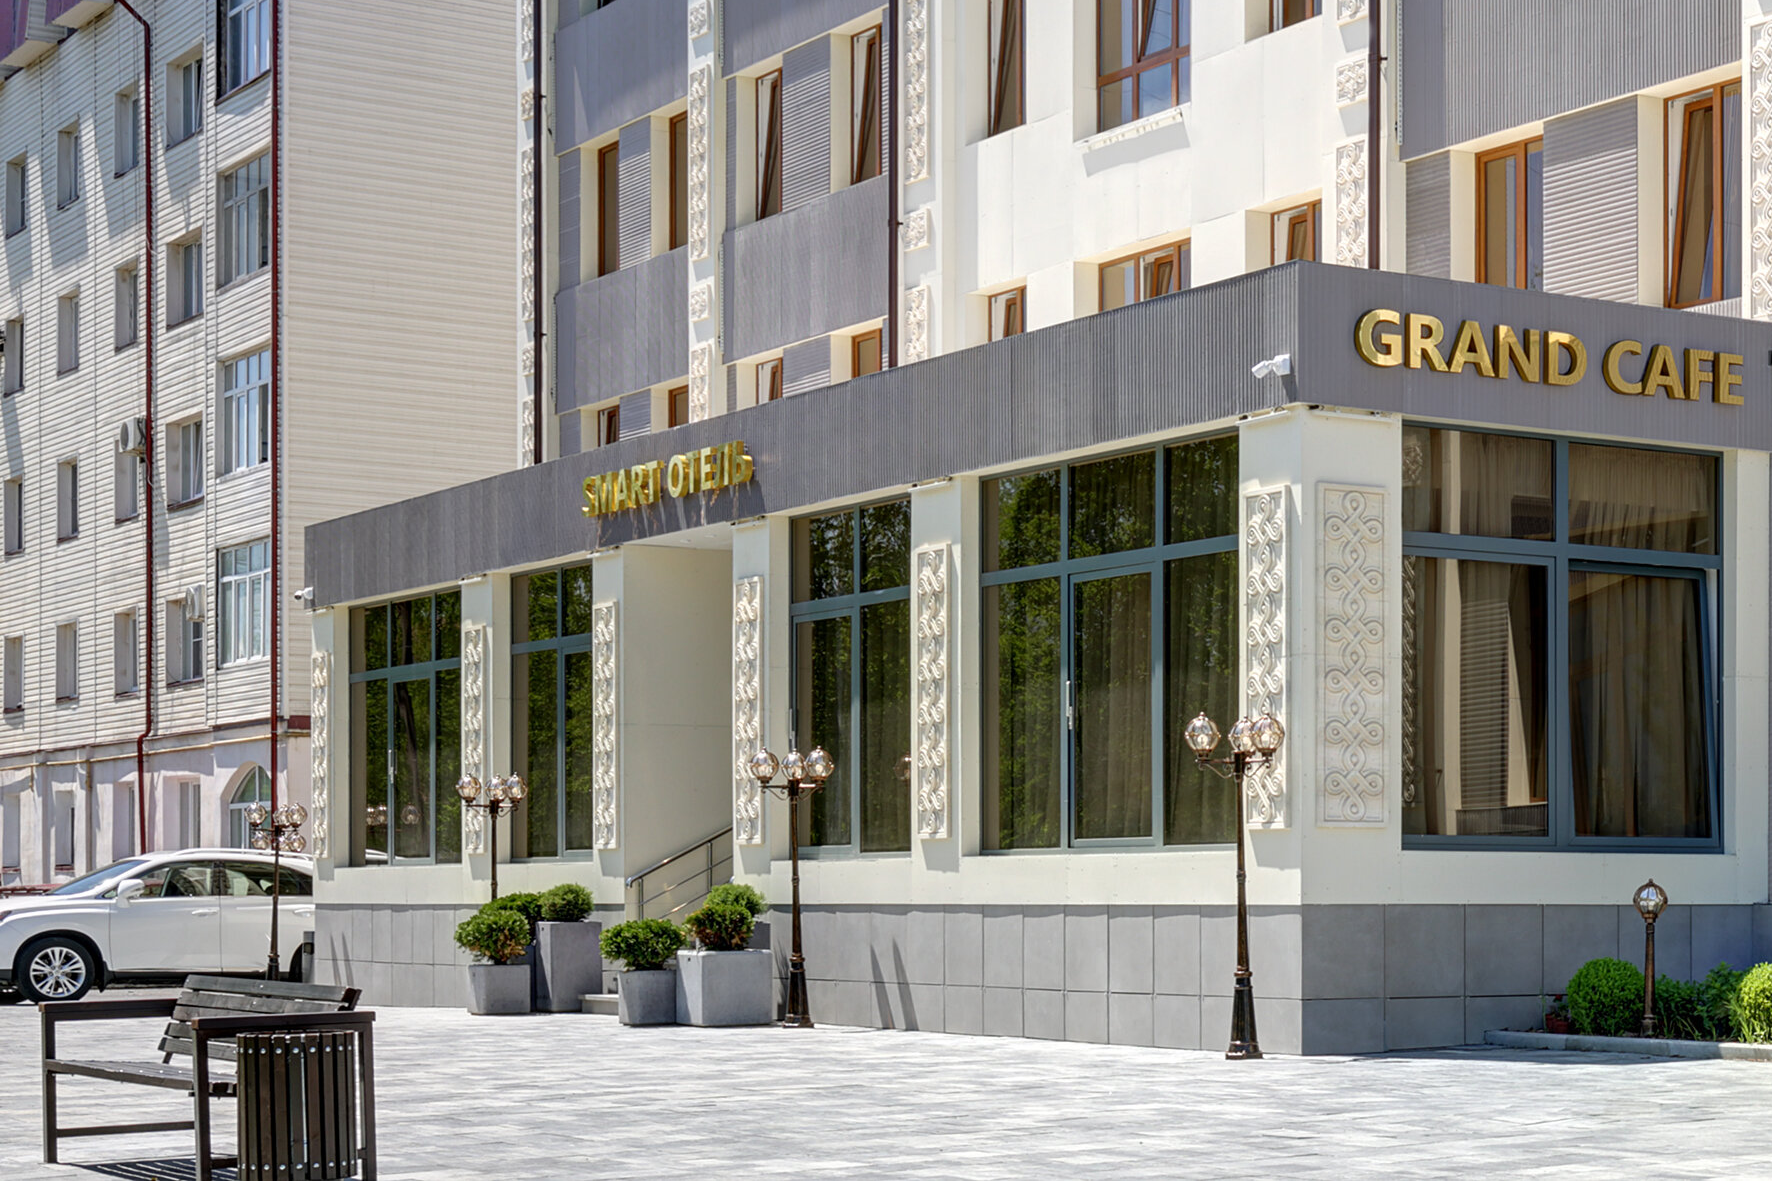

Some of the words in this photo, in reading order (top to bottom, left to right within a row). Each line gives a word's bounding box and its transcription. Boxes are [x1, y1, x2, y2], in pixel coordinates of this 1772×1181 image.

[1354, 308, 1587, 386] GRAND
[1602, 339, 1745, 406] CAFE
[582, 460, 664, 518] SMART
[667, 440, 753, 499] ОТЕЛЬ
